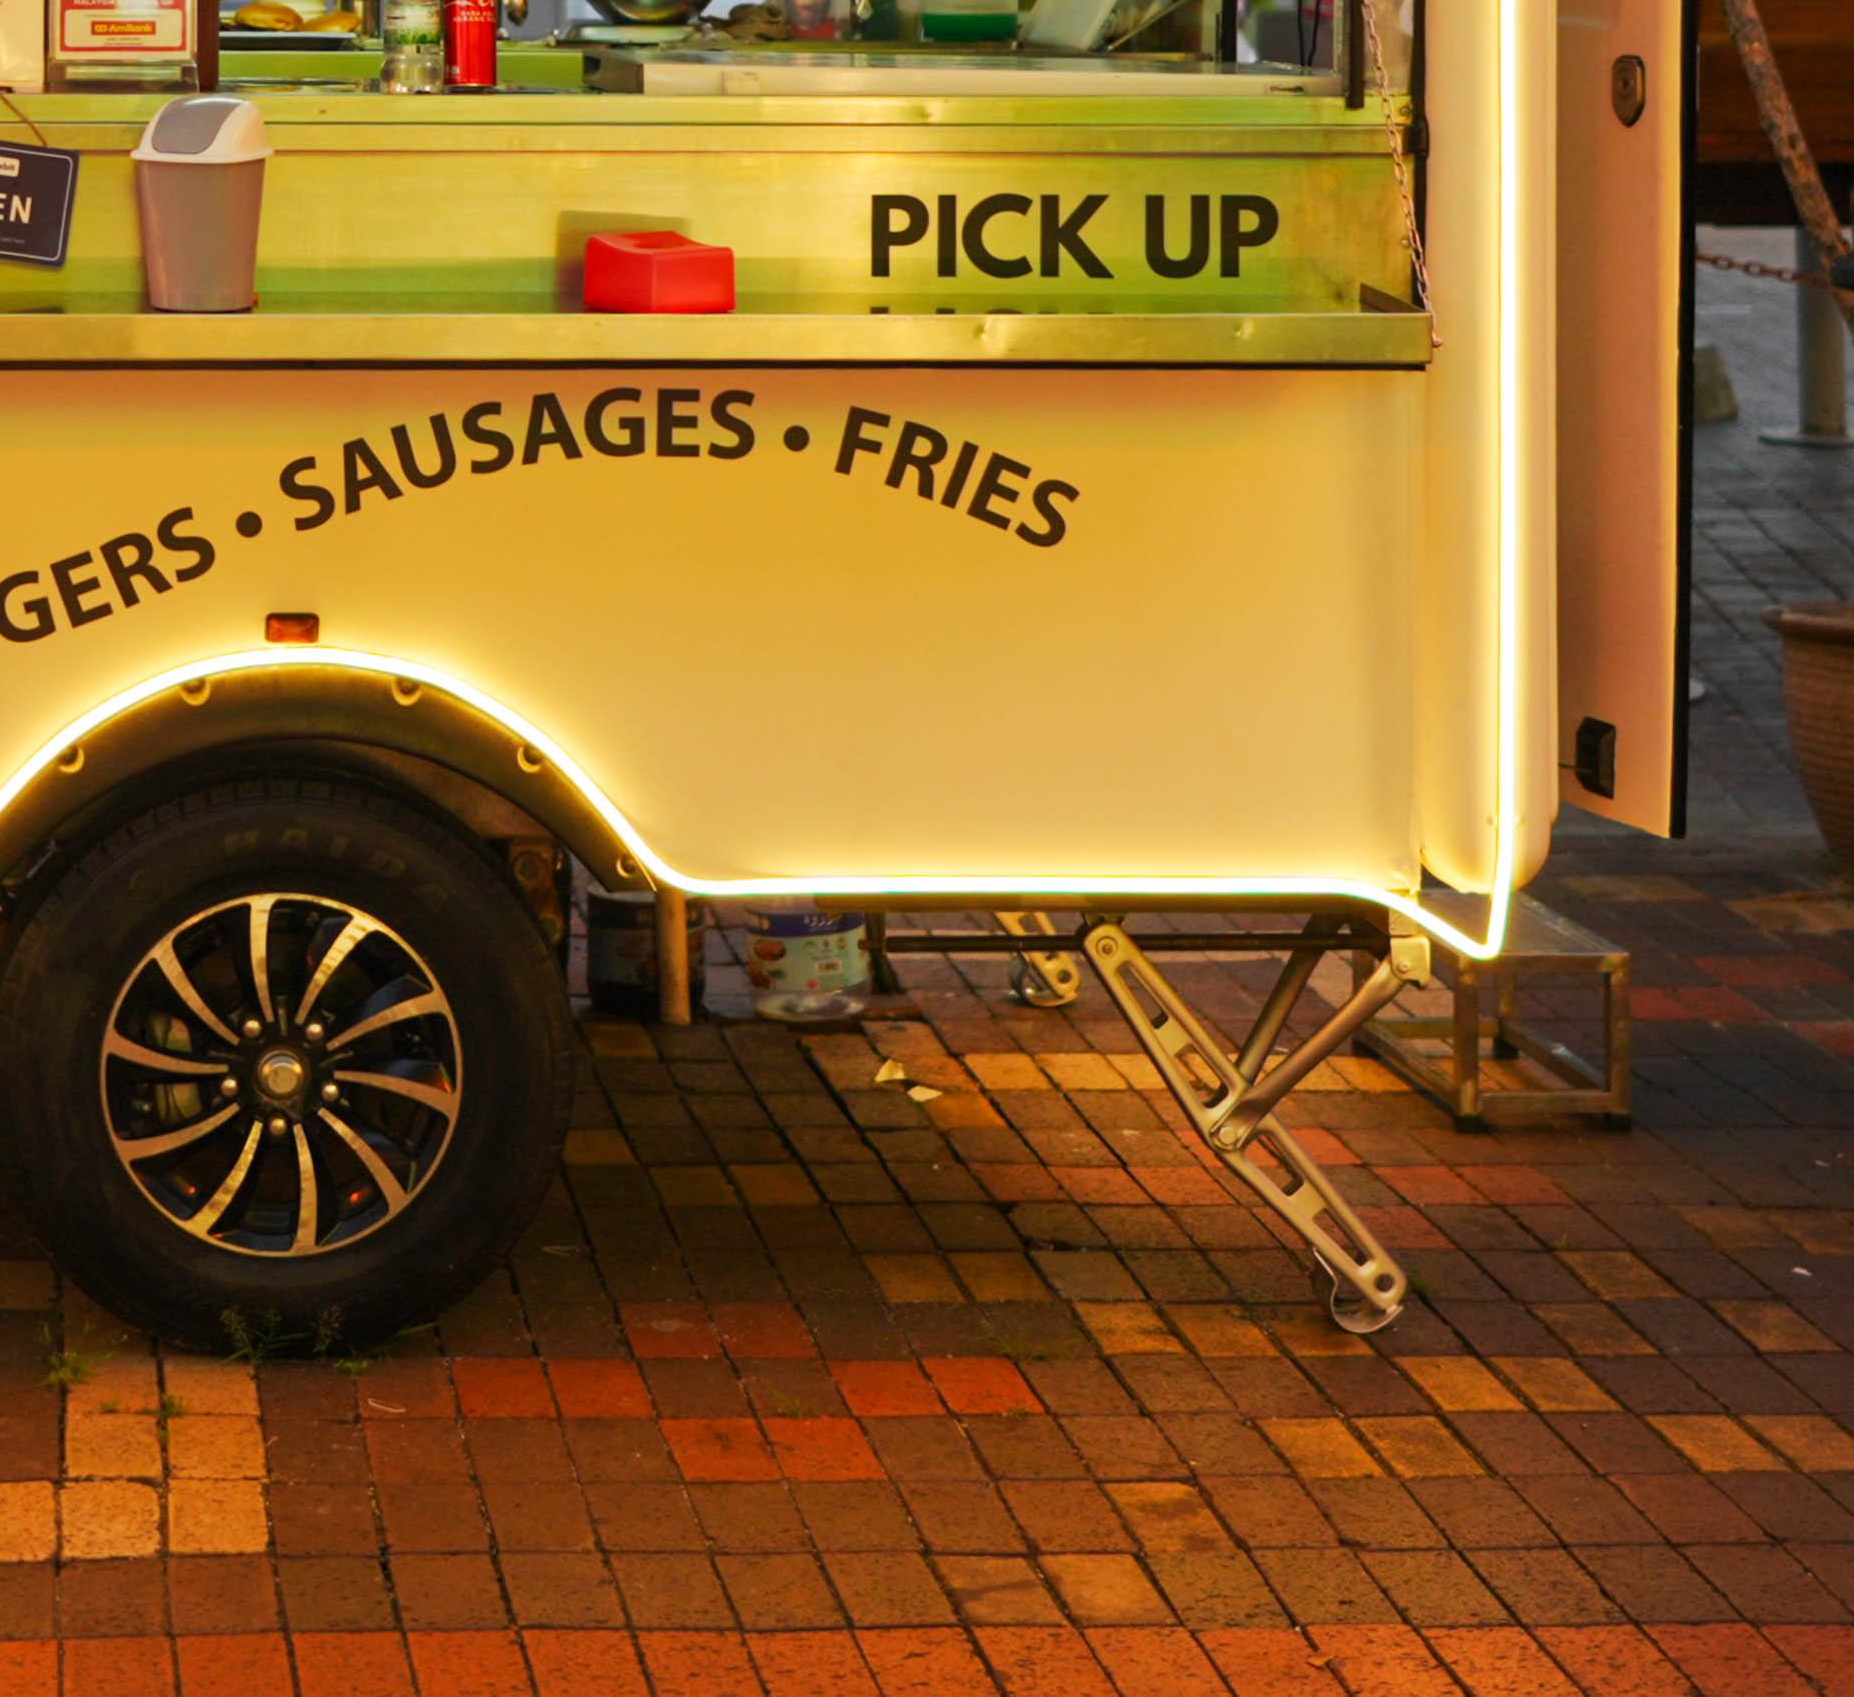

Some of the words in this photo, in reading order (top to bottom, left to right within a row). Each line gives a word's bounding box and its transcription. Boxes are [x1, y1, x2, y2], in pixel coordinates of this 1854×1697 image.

[108, 23, 153, 33] AmBank
[870, 192, 1115, 280] PICK
[1144, 193, 1281, 280] UP
[277, 386, 757, 533] SAUSAGES
[833, 404, 1082, 549] FRIES
